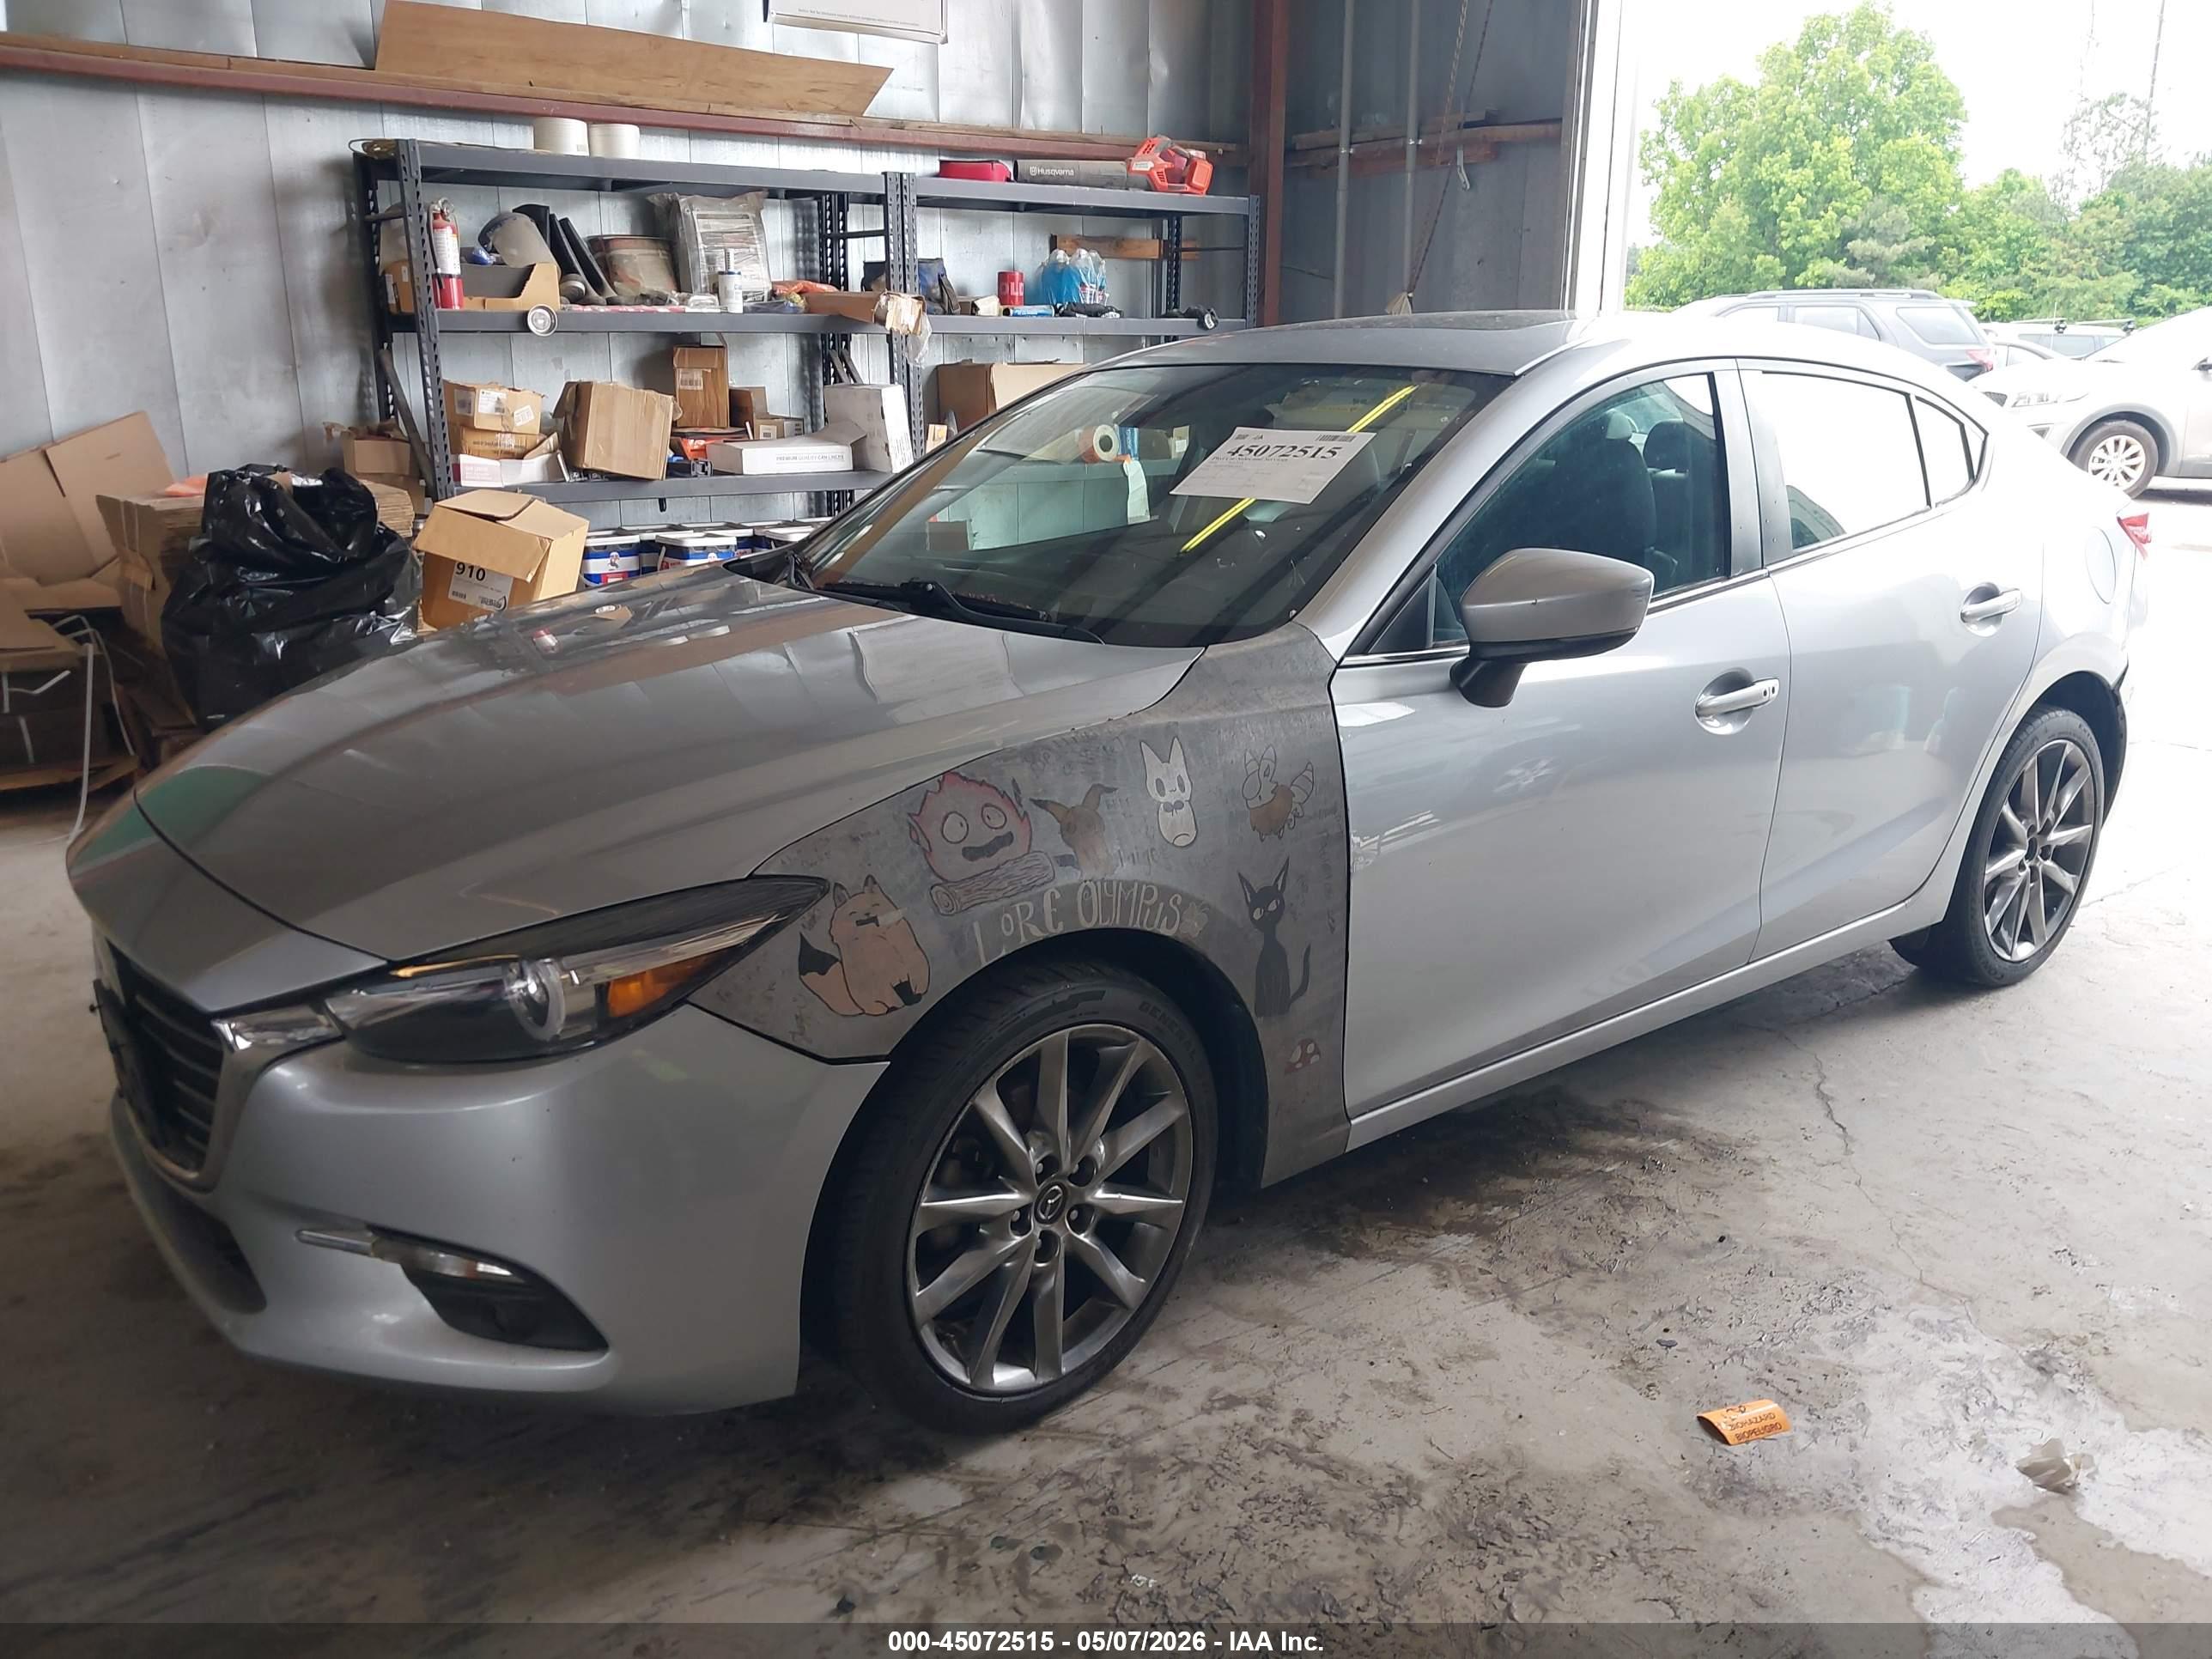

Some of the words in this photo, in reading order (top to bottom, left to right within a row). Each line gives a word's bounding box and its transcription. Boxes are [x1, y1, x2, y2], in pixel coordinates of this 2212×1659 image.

[1037, 166, 1075, 177] Husqvarna
[1226, 444, 1343, 459] 45072515
[455, 562, 486, 581] 910
[973, 887, 1065, 967] LORE
